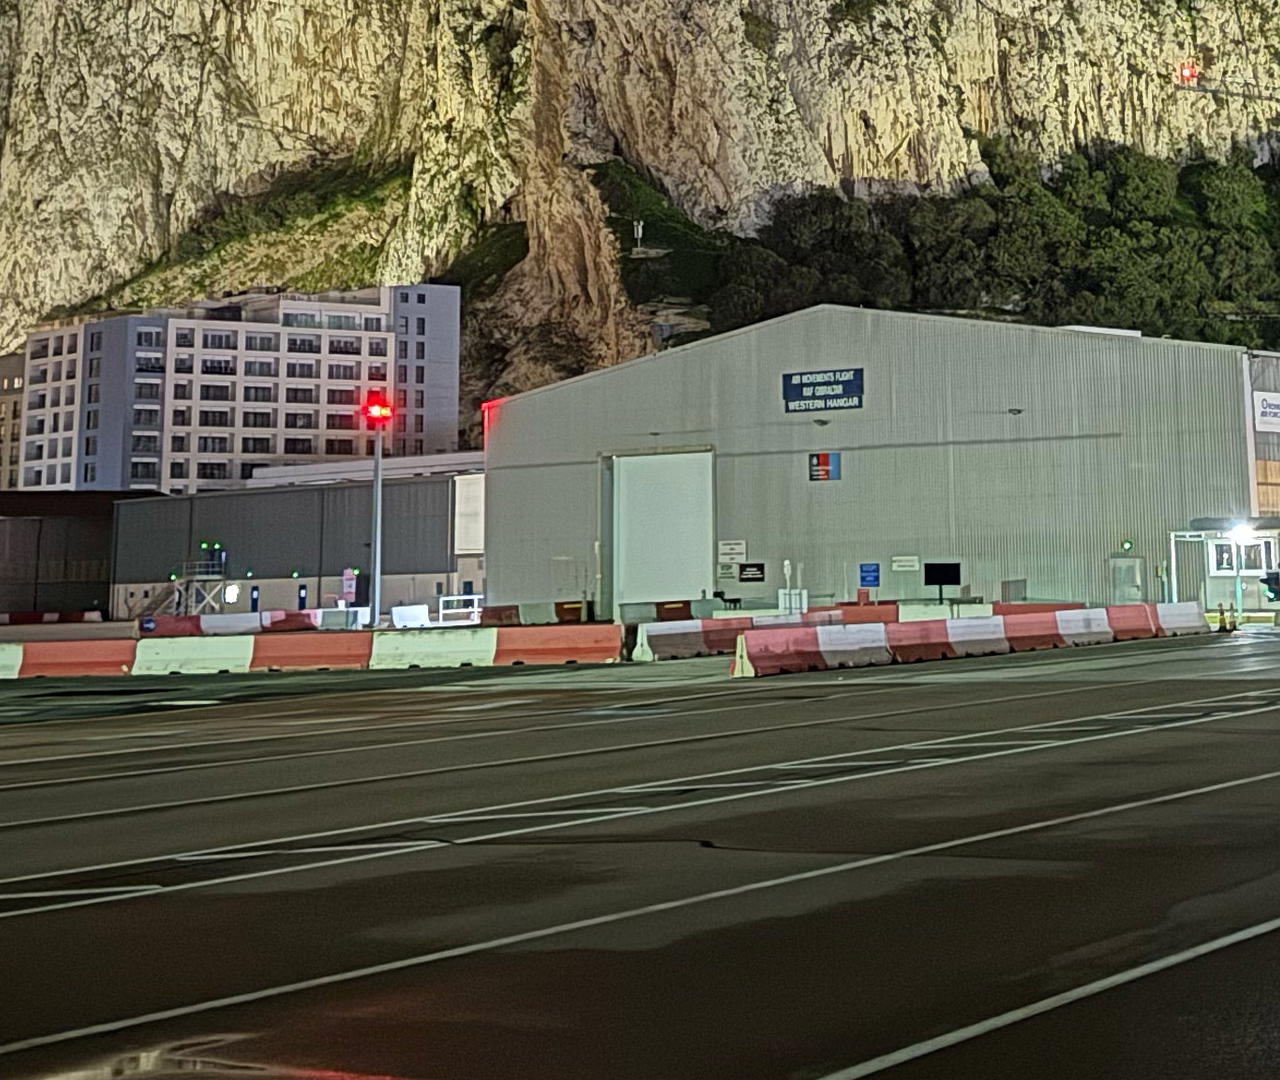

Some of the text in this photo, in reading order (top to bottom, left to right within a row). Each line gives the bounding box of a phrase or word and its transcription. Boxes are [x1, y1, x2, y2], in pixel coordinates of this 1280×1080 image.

[835, 371, 854, 381] FLIGHT
[788, 397, 858, 410] WESTERN HANGAR
